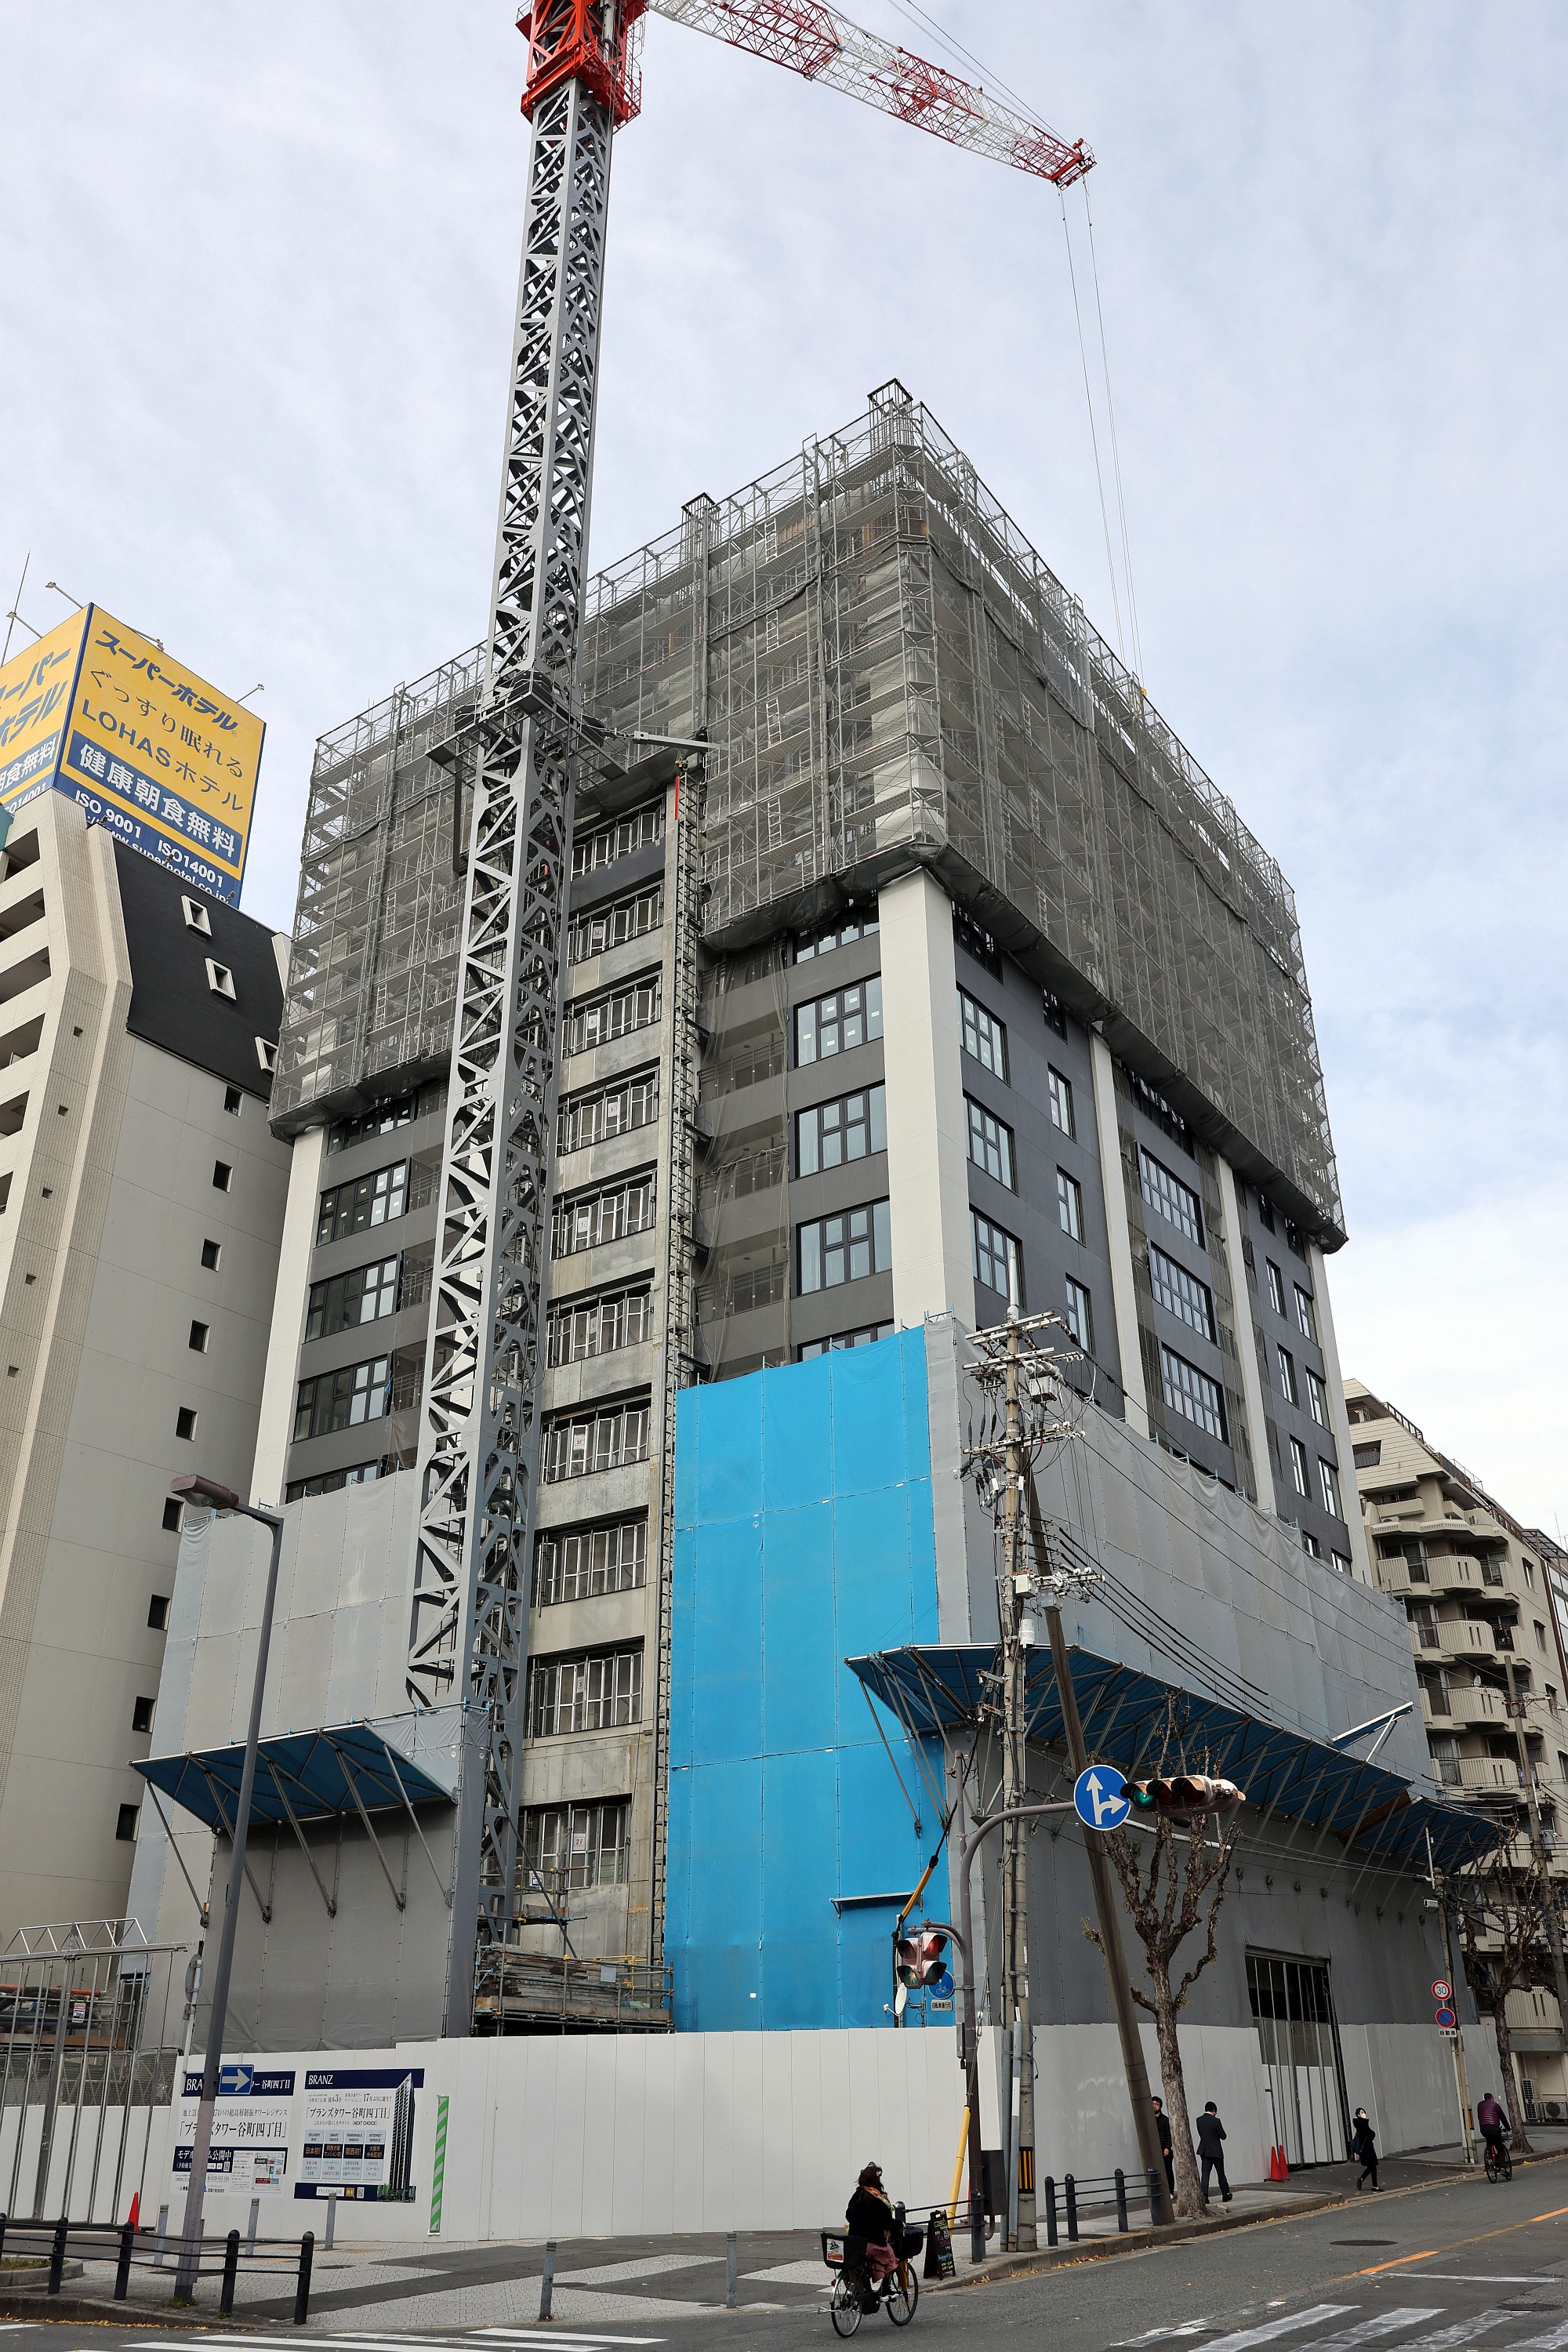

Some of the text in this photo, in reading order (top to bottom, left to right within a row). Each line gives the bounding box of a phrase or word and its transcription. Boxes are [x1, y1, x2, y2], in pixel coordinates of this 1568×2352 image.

[0, 648, 72, 702] ーパー
[94, 630, 239, 731] スーパーホテル
[90, 669, 244, 779] ぐっすり眠れる
[82, 699, 244, 813] LOHASホテル
[74, 789, 142, 839] ISO 9001
[79, 742, 235, 858] 健康朝食無料
[1436, 1986, 1447, 1995] 30
[186, 2078, 203, 2091] BRA
[261, 2079, 291, 2089] 谷町四丁目
[308, 2074, 334, 2085] BRANZ
[306, 2107, 391, 2119] 「ブランズタワー谷町四丁目」
